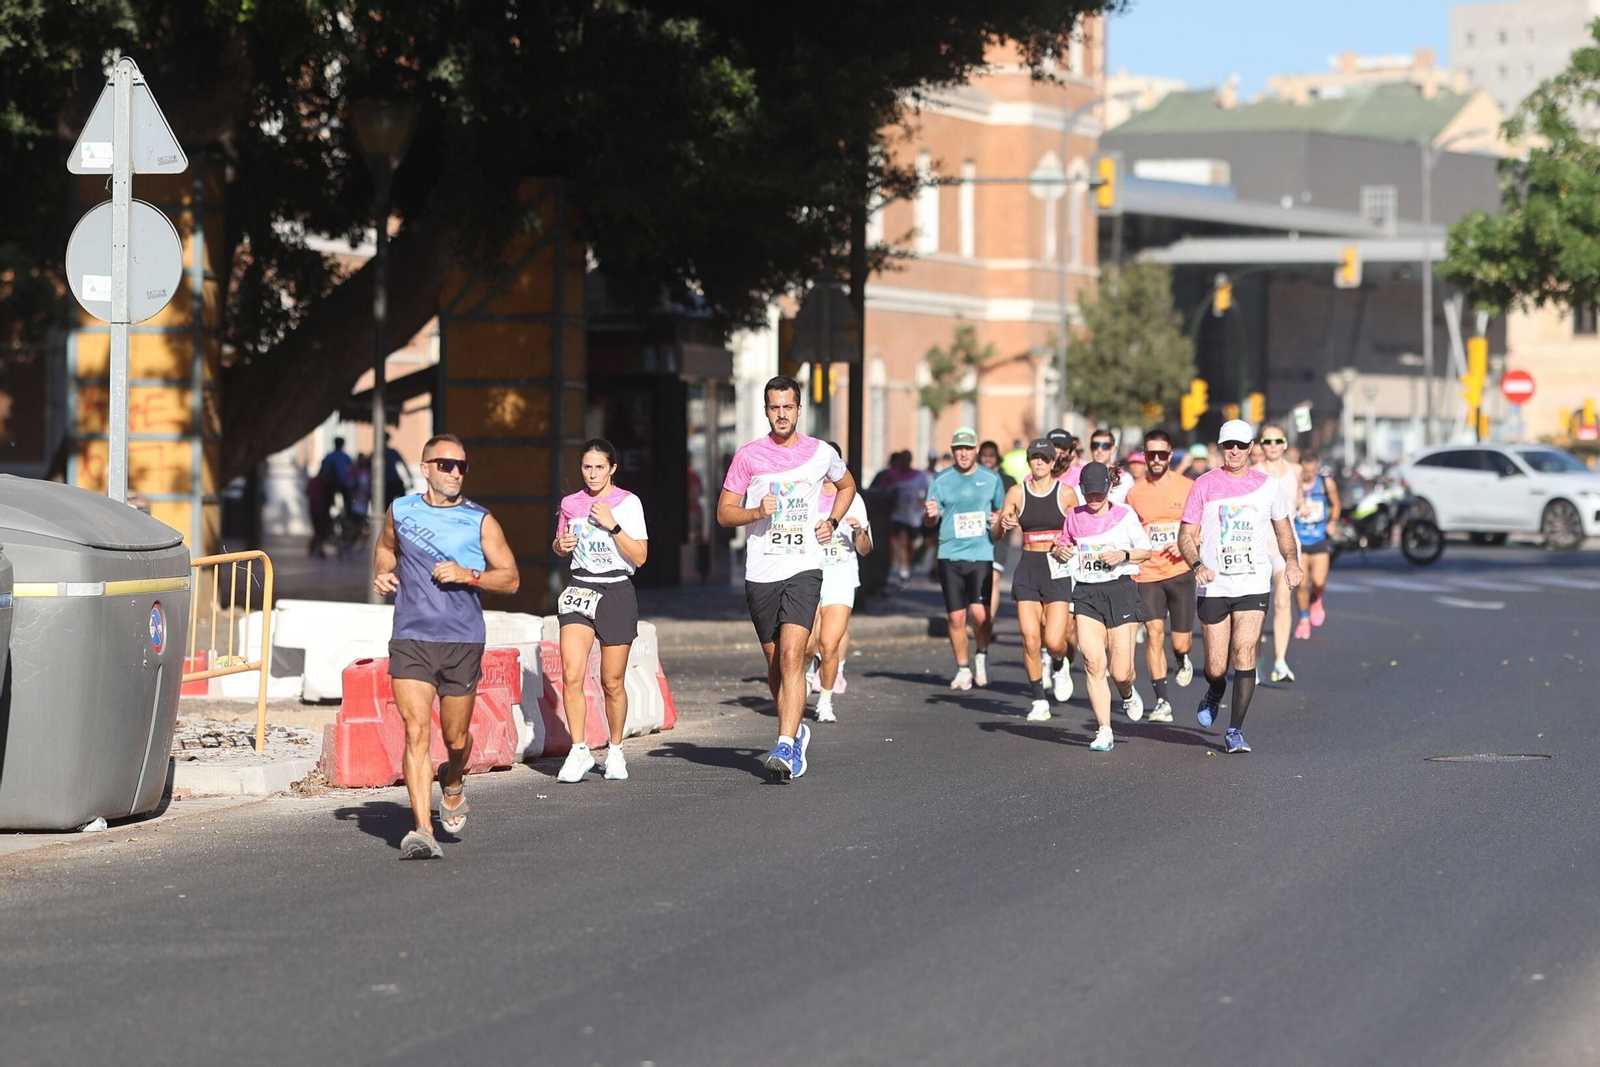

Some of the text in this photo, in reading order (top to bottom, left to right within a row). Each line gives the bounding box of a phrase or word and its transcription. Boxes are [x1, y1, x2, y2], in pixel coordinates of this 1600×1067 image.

[785, 514, 808, 522] 2025
[959, 520, 982, 530] 221
[771, 532, 804, 545] 213
[1151, 532, 1176, 542] 431
[1224, 553, 1252, 565] 661
[1084, 561, 1111, 571] 464
[563, 595, 591, 610] 341
